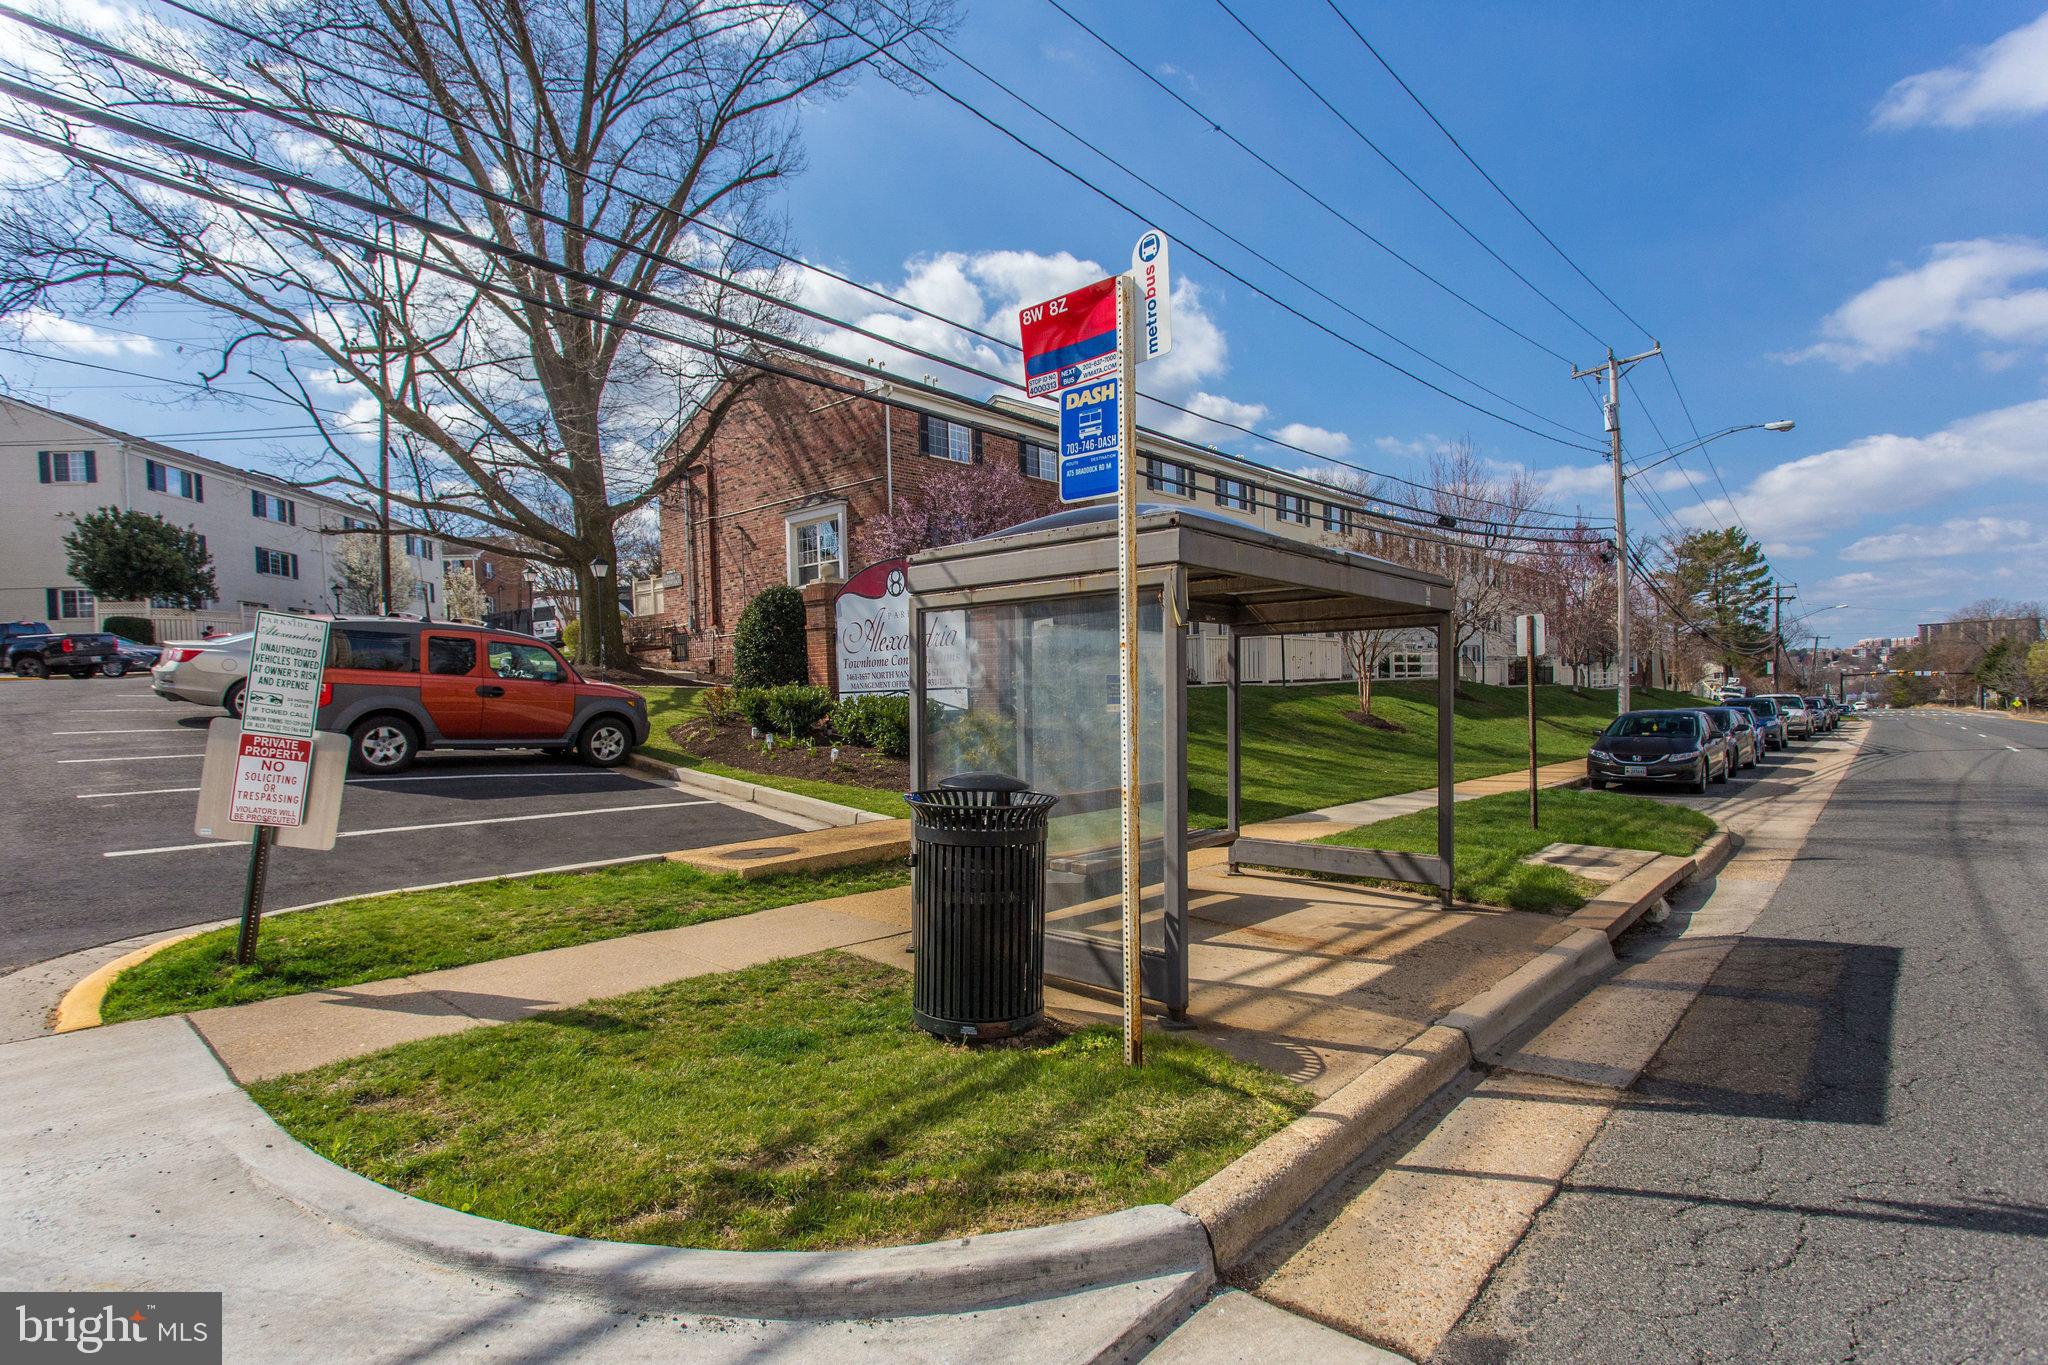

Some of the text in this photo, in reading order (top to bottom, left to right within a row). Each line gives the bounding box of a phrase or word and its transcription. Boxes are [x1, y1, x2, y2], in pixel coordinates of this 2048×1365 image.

[1022, 305, 1044, 326] 8W
[1145, 264, 1159, 354] metrobus
[1082, 353, 1117, 371] 202-637-7000
[1061, 367, 1077, 378] NEXT
[1082, 363, 1117, 378] WMATA.COM
[1029, 378, 1042, 387] STOP
[1062, 377, 1075, 385] BUS
[1029, 382, 1057, 394] 4000313
[1066, 383, 1115, 410] DASH
[1066, 434, 1117, 456] 703-746-DASH
[1091, 453, 1117, 462] DESTINATION
[1075, 465, 1098, 475] BRADDOCK
[261, 616, 310, 629] PARKSIDE
[258, 625, 322, 643] Alexandria
[260, 642, 318, 658] UNAUTHORIZED
[255, 653, 320, 669] VEHICLES TOWED
[843, 656, 889, 669] Townhome
[253, 664, 318, 681] AT OWNER'S RISK
[872, 671, 895, 679] NORTH
[258, 676, 310, 691] AND EXPENSE
[850, 681, 891, 689] MANAGEMENT
[261, 707, 288, 716] TOWED
[289, 711, 309, 719] CALL
[253, 736, 299, 750] PRIVATE
[244, 746, 304, 760] PROPERTY
[261, 760, 285, 772] NO
[245, 771, 298, 785] SOLICITING
[264, 783, 276, 792] OR
[238, 790, 299, 805] TRESPASSING
[236, 805, 297, 817] VIOLATORS WILL
[246, 813, 297, 824] PROSECUTED
